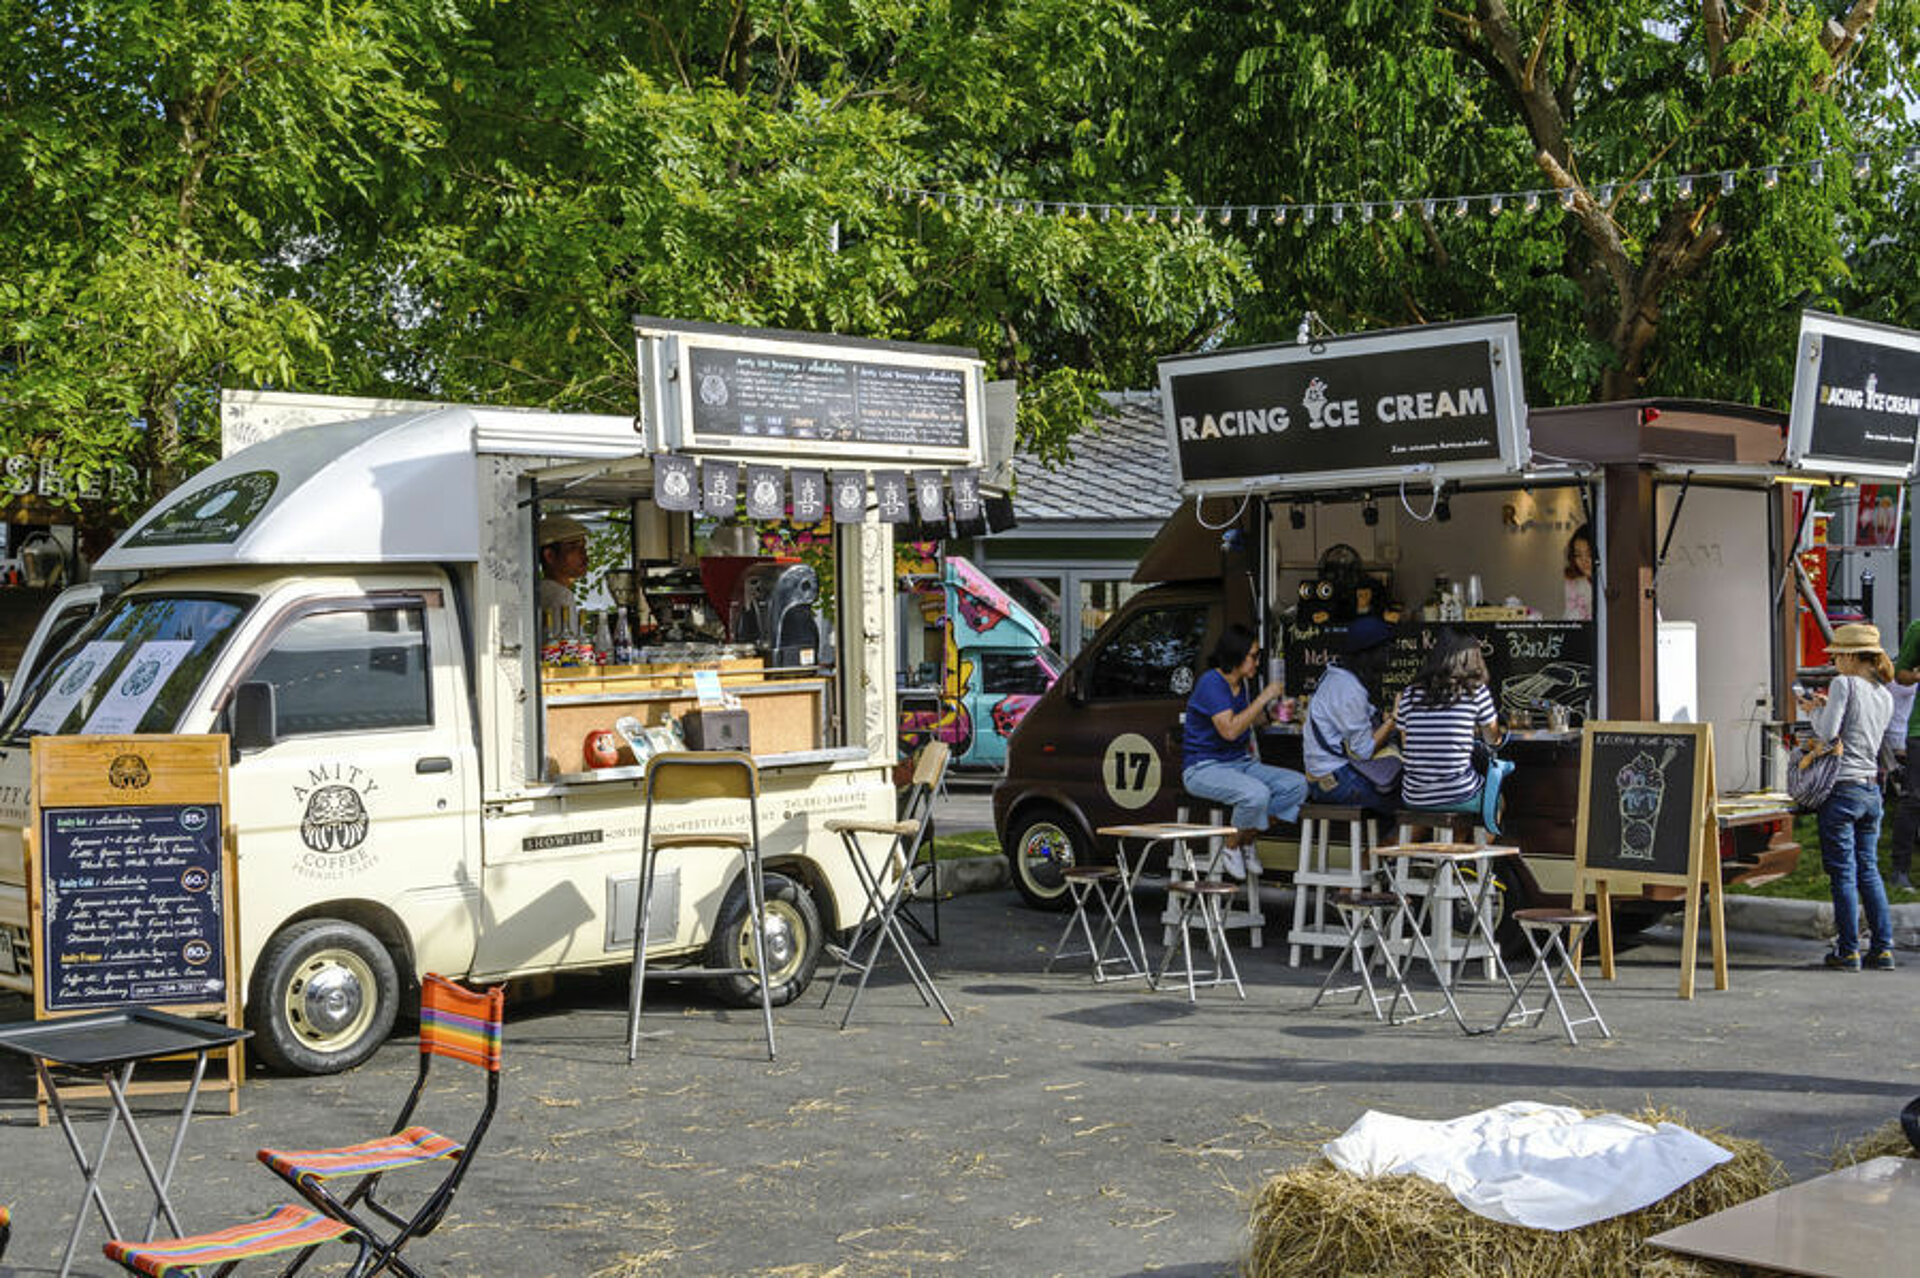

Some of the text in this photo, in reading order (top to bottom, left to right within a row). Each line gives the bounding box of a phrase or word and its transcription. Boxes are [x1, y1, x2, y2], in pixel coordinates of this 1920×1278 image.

[1820, 385, 1863, 408] RACING
[1180, 386, 1489, 441] RACING ICE CREAM
[292, 762, 378, 802] AMITY
[1116, 752, 1150, 791] 17
[527, 831, 600, 850] SHOWTIME
[303, 846, 369, 870] COFFEE
